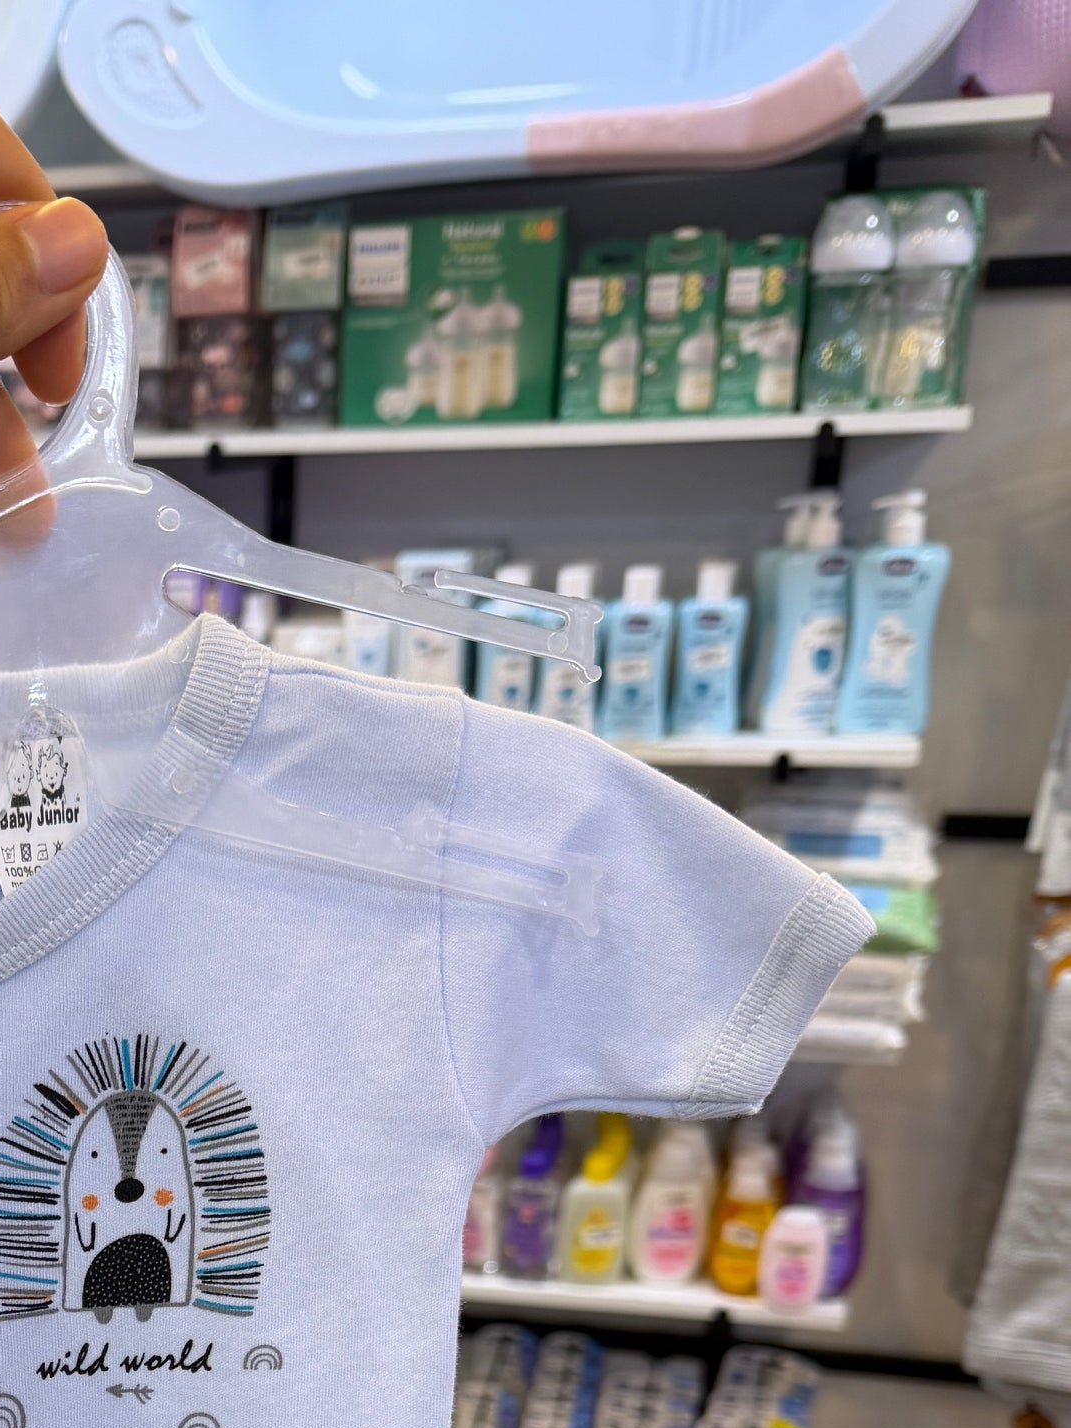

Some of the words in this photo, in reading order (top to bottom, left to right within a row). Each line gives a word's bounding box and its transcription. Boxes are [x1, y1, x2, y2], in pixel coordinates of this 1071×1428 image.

[0, 806, 33, 832] Baby
[37, 804, 80, 827] Junior
[36, 1342, 109, 1380] wild
[119, 1339, 213, 1374] world
